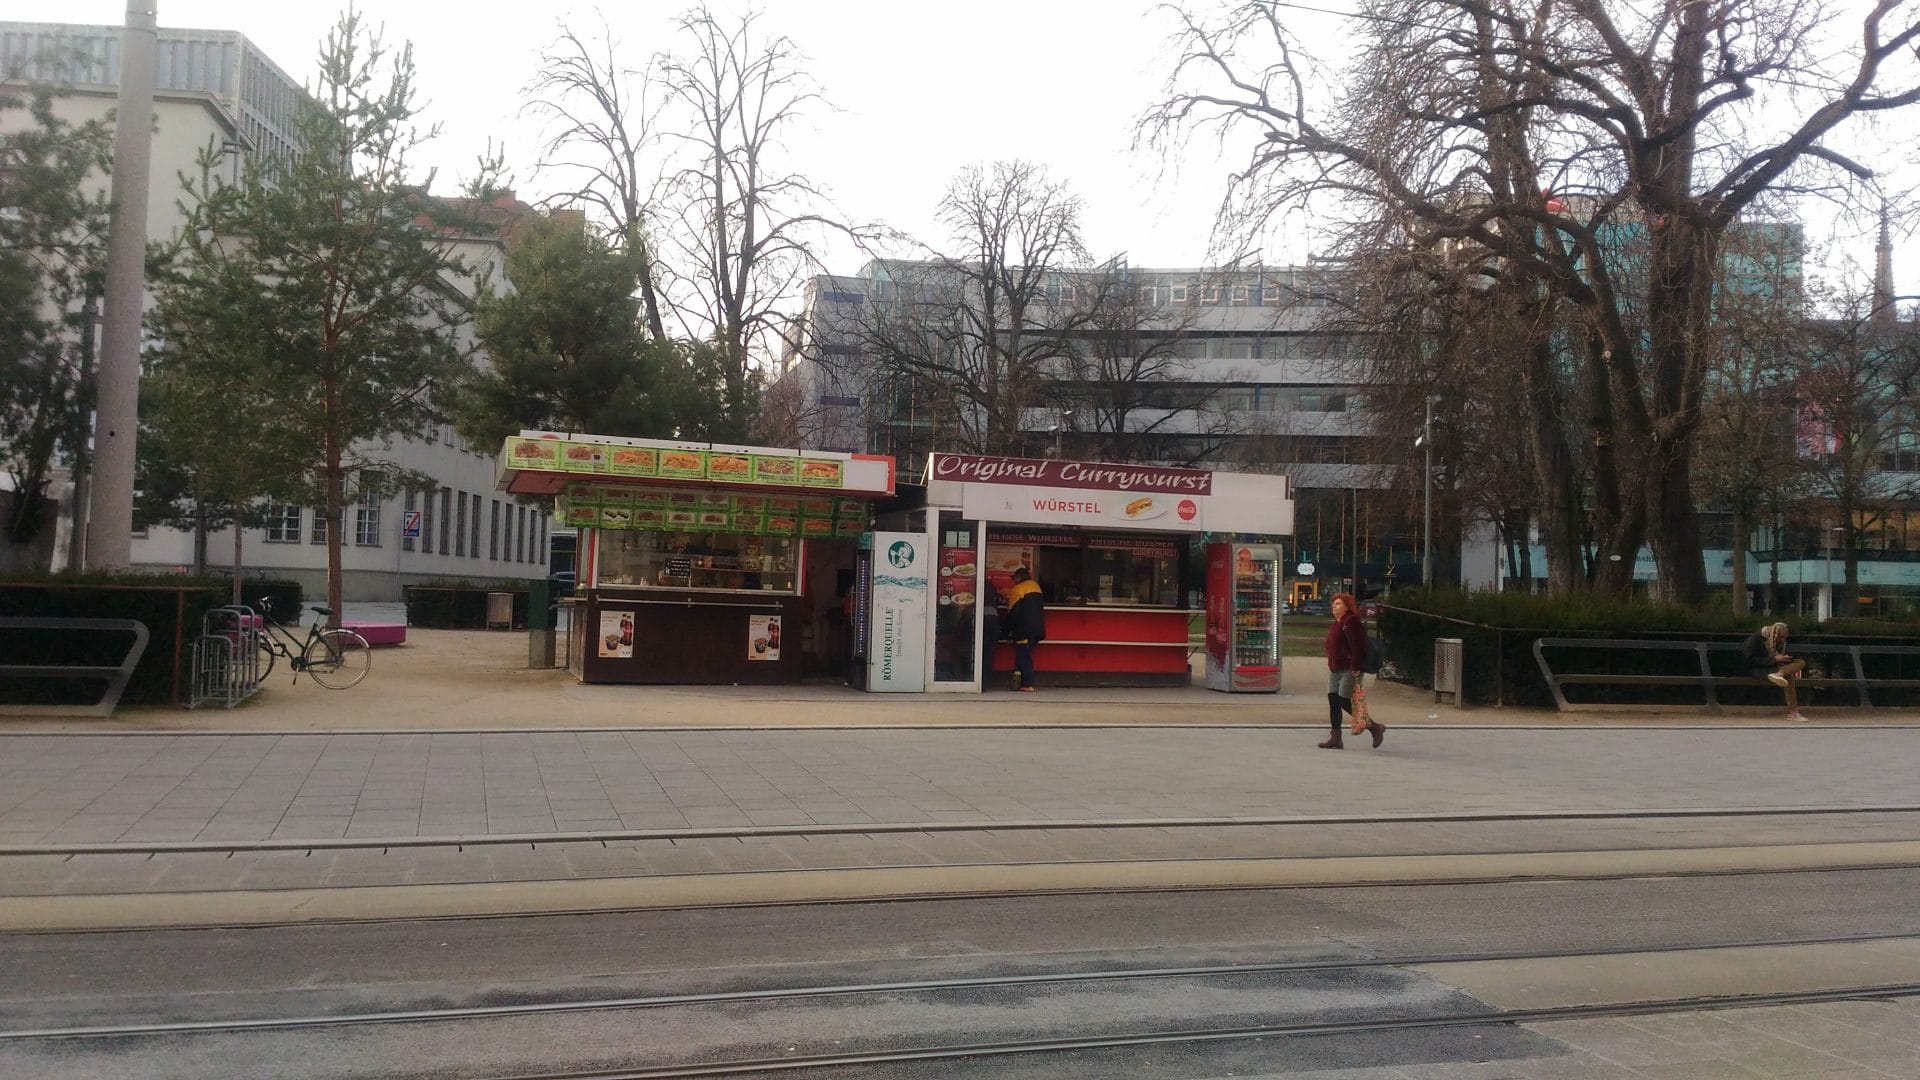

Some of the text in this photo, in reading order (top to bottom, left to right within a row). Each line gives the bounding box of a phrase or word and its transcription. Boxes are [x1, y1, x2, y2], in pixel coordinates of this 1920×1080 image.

[937, 456, 1210, 490] Original Currywurst
[1033, 498, 1102, 514] WÜRSTEL
[882, 607, 894, 681] RÖMERQUELLE
